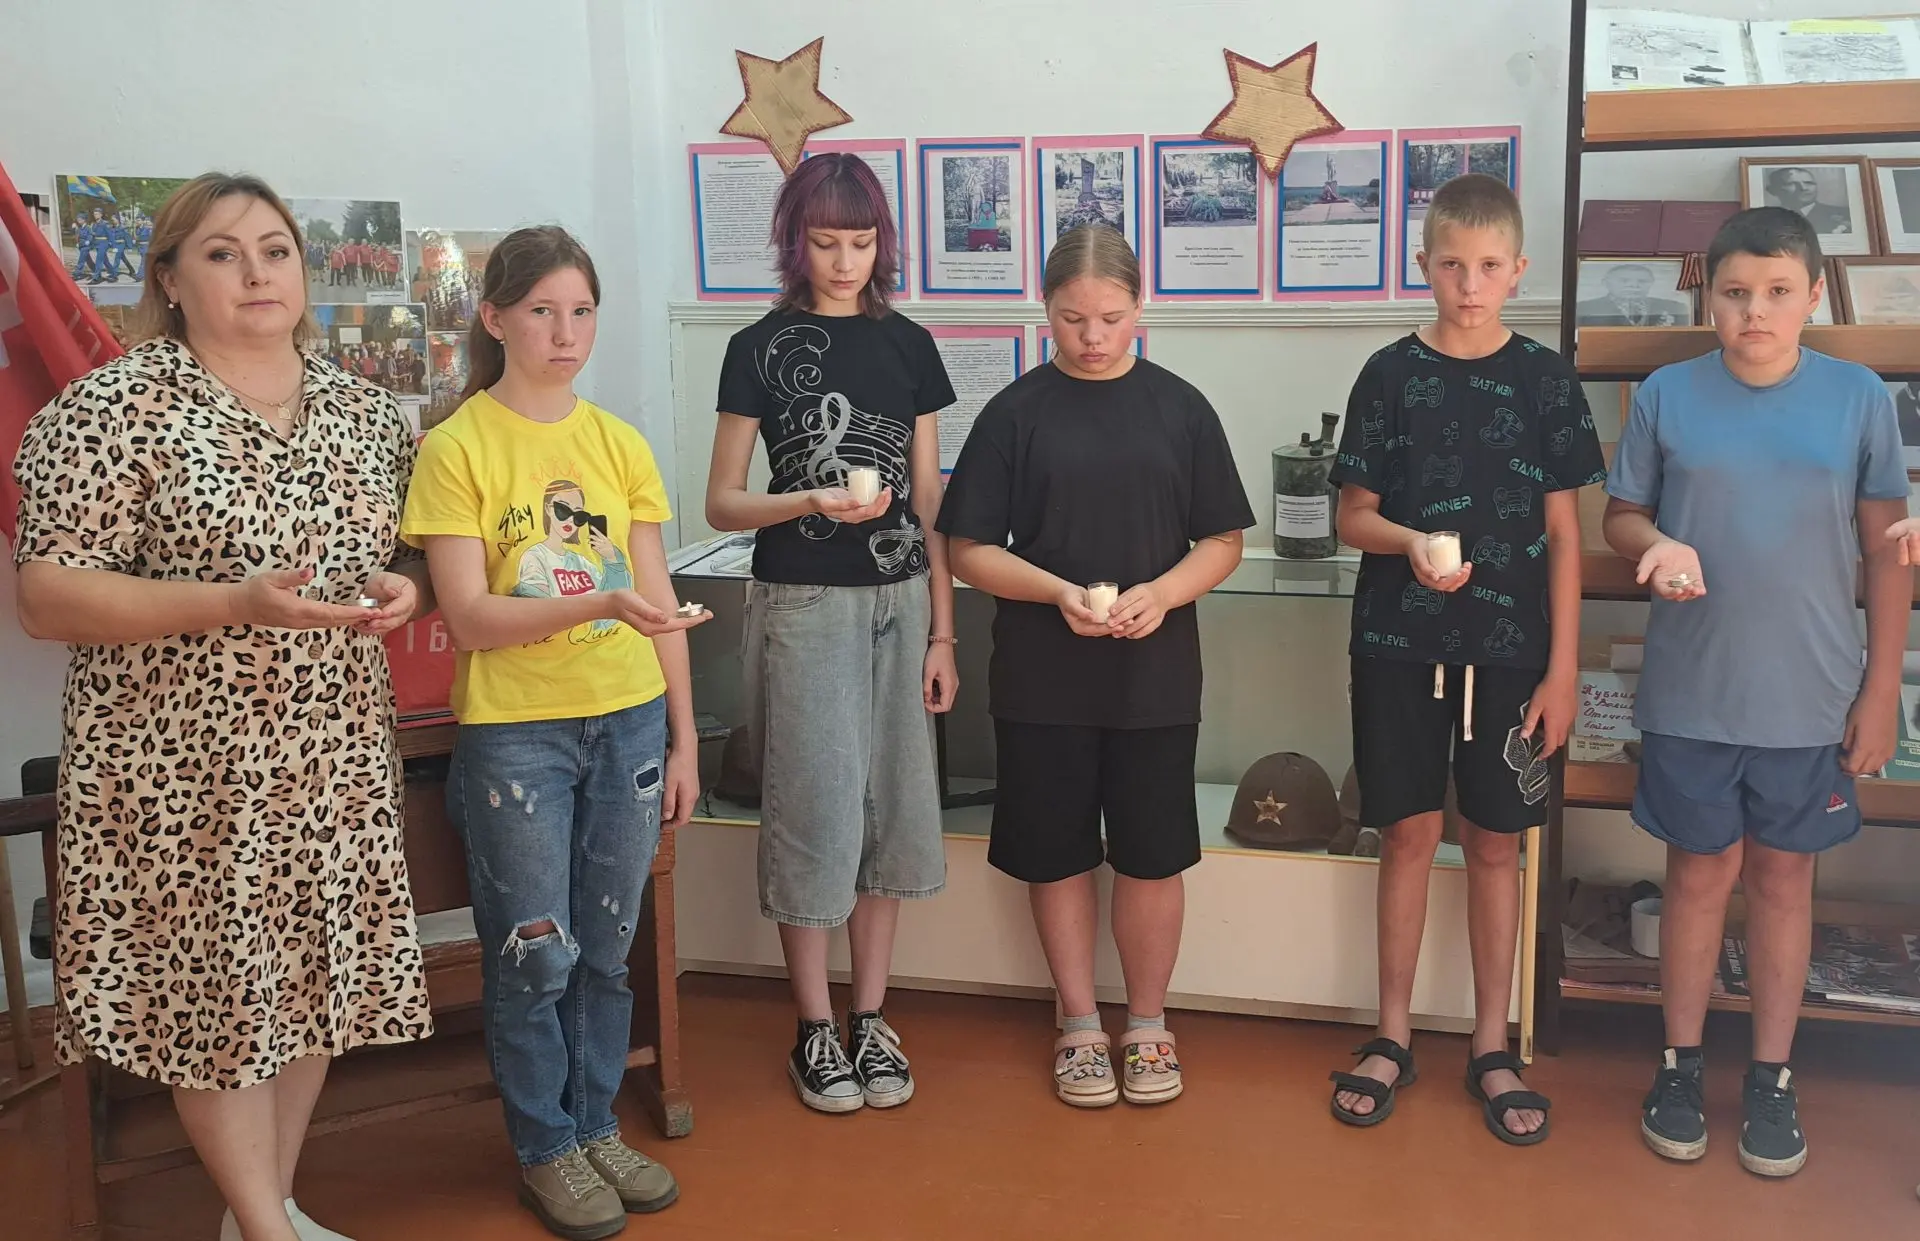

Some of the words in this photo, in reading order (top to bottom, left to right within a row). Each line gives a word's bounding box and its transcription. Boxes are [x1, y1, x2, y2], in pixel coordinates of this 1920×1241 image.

[1469, 375, 1495, 392] LEVEL
[1495, 382, 1515, 398] NEW
[1421, 496, 1472, 518] WINNER
[498, 503, 534, 538] Stay
[1526, 533, 1548, 559] AME
[556, 573, 593, 592] FAKE
[1472, 585, 1497, 601] LEVEL
[1495, 592, 1515, 608] NEW
[1363, 631, 1380, 645] NEW
[1381, 633, 1410, 648] LEVEL
